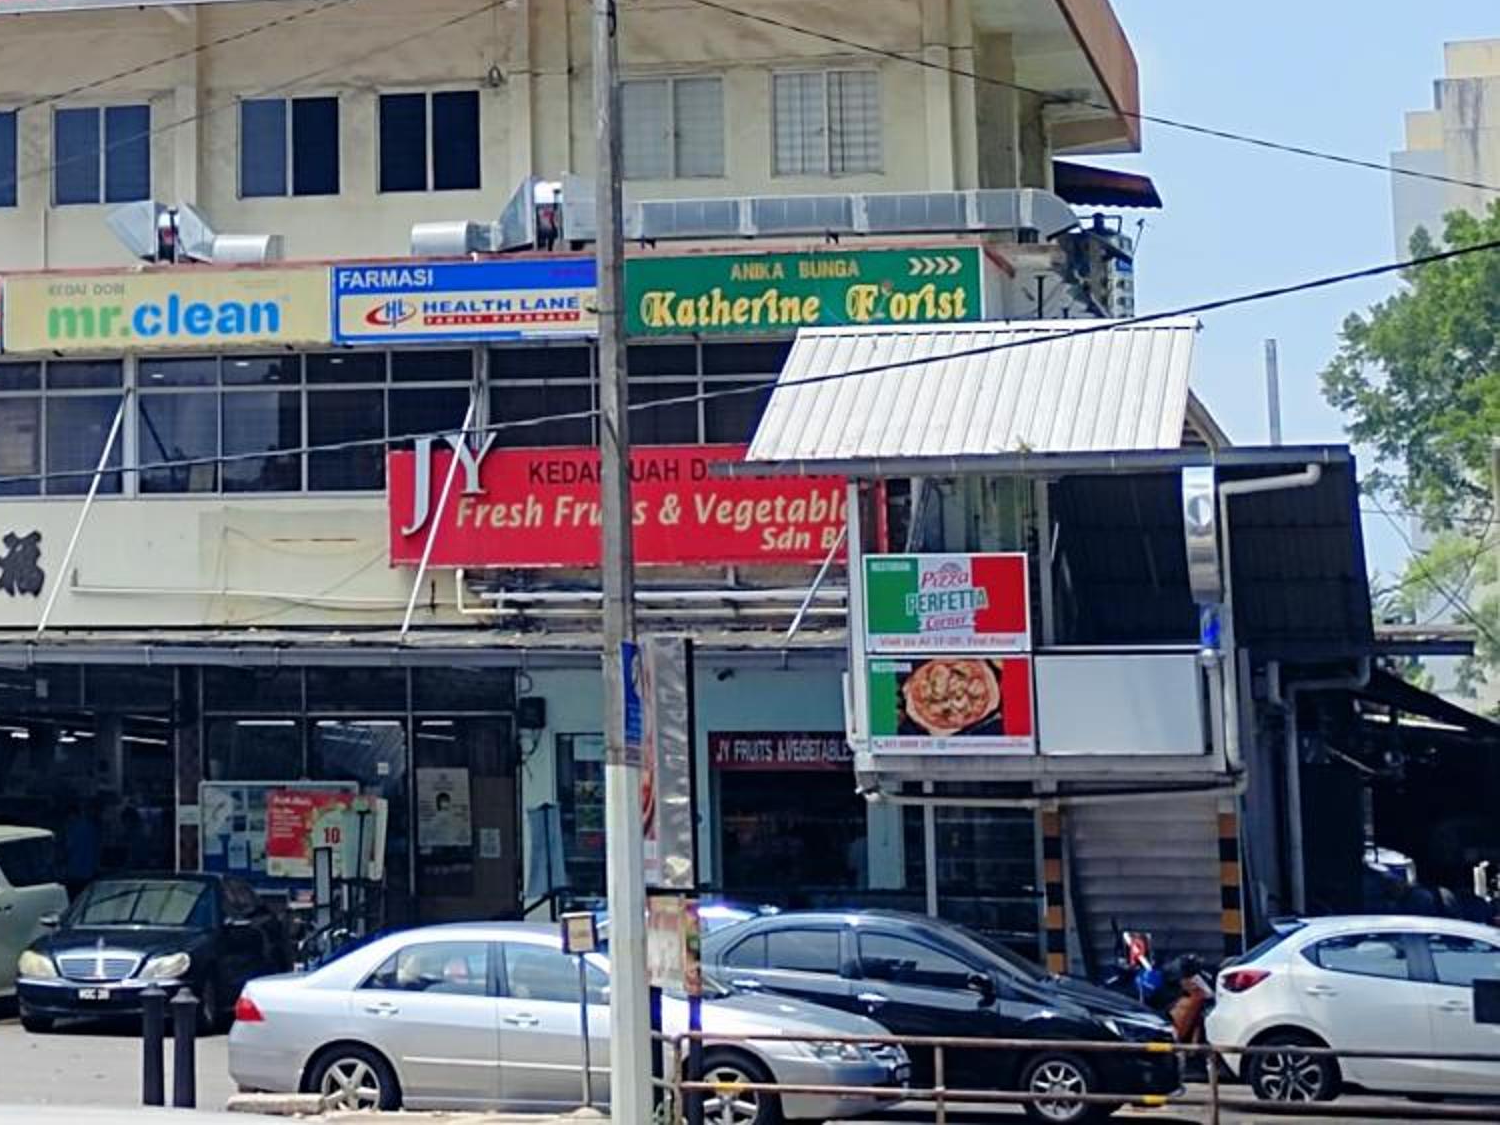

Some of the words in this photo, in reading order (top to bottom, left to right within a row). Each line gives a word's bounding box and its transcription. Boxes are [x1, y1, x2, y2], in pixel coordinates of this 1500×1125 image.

[339, 269, 434, 290] FARMASI
[798, 260, 861, 279] BUNGA
[423, 298, 512, 314] HEALTH
[519, 296, 581, 311] LANE
[639, 287, 820, 328] Katherine
[629, 458, 680, 483] UAH
[401, 430, 498, 537] JY
[456, 494, 543, 529] Fresh
[553, 495, 648, 528] Frus
[658, 492, 682, 525] &
[760, 525, 811, 551] Sdn
[906, 588, 989, 615] PERFETTA
[733, 739, 773, 762] FRUITS
